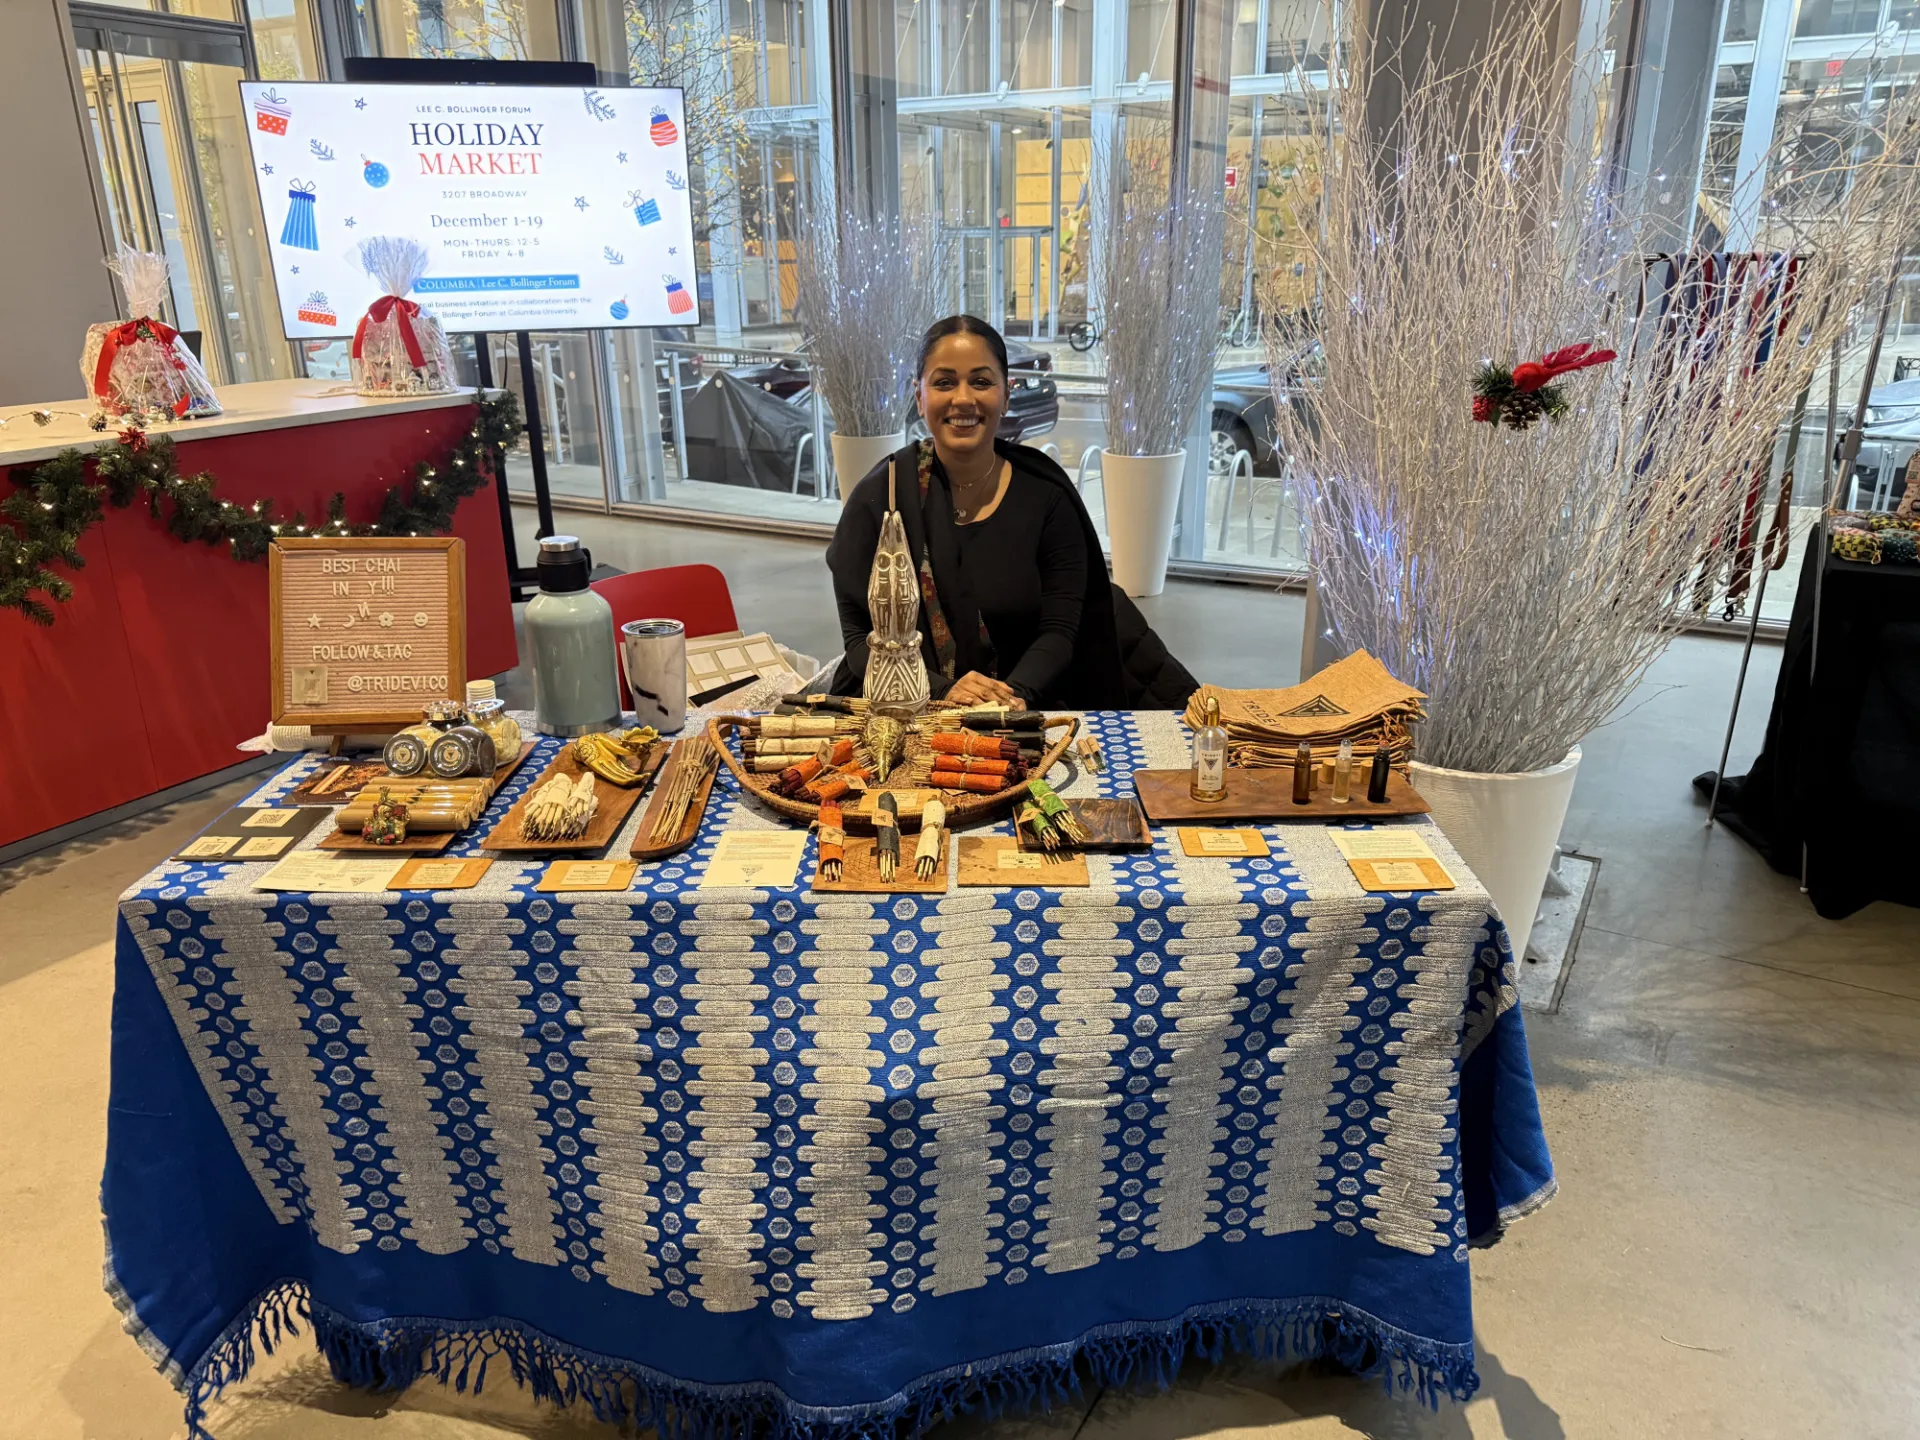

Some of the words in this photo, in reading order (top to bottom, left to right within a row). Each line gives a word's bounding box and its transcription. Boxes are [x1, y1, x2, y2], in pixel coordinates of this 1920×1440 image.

[416, 105, 432, 113] LEE
[435, 105, 445, 113] C.
[447, 105, 497, 114] BOLLINGER
[500, 106, 531, 114] FORUM
[409, 122, 544, 146] HOLIDAY
[418, 152, 542, 175] MARKET
[442, 190, 466, 199] 3207
[470, 190, 527, 199] BROADWAY
[430, 213, 508, 228] December
[514, 215, 543, 229] 1-19
[482, 279, 496, 288] Lee
[510, 277, 547, 289] Bollinger
[549, 277, 576, 286] Forum
[442, 311, 473, 319] Bollinger
[507, 308, 542, 316] Columbia
[322, 558, 359, 574] BEST
[366, 557, 400, 573] CHAI
[332, 580, 349, 596] IN
